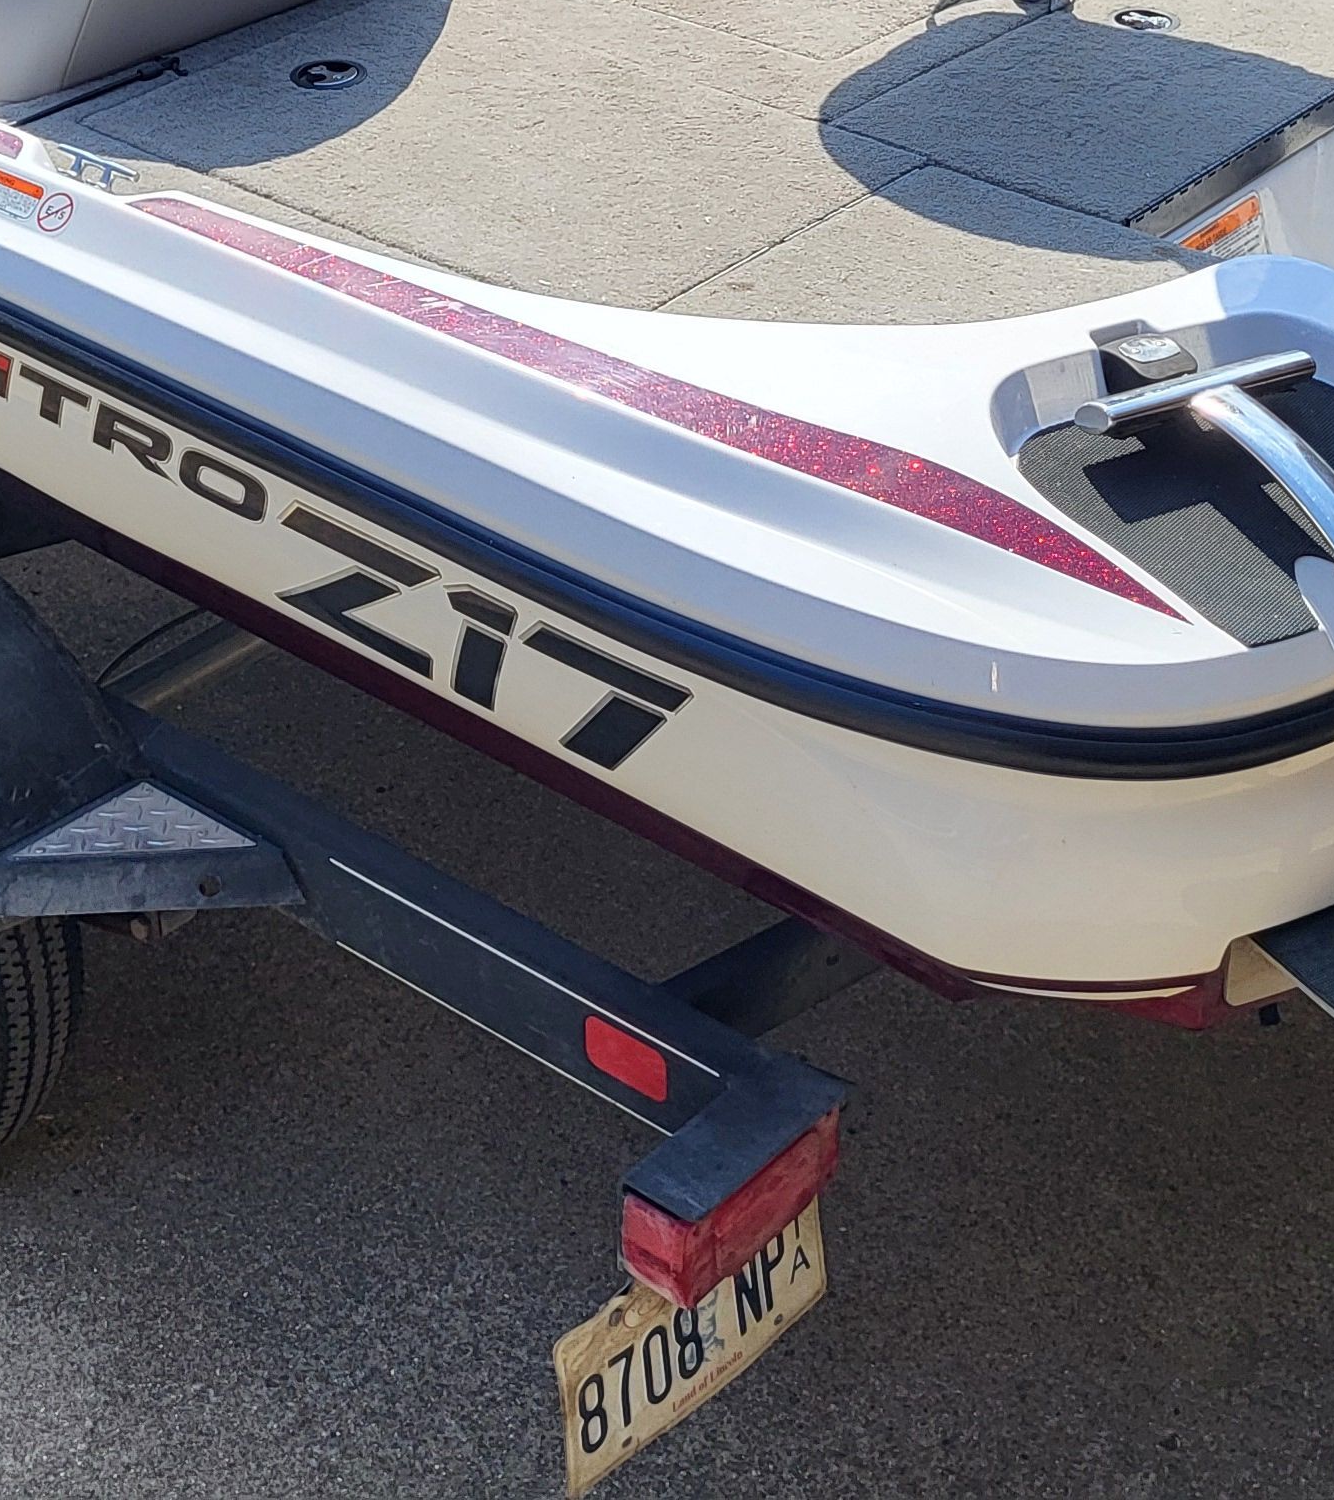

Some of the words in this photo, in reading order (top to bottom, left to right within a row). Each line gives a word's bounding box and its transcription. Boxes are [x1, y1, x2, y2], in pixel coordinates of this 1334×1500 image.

[276, 500, 695, 771] Z17
[578, 1306, 705, 1454] 8708
[732, 1231, 785, 1337] NP
[672, 1385, 697, 1413] Land
[698, 1375, 709, 1391] of
